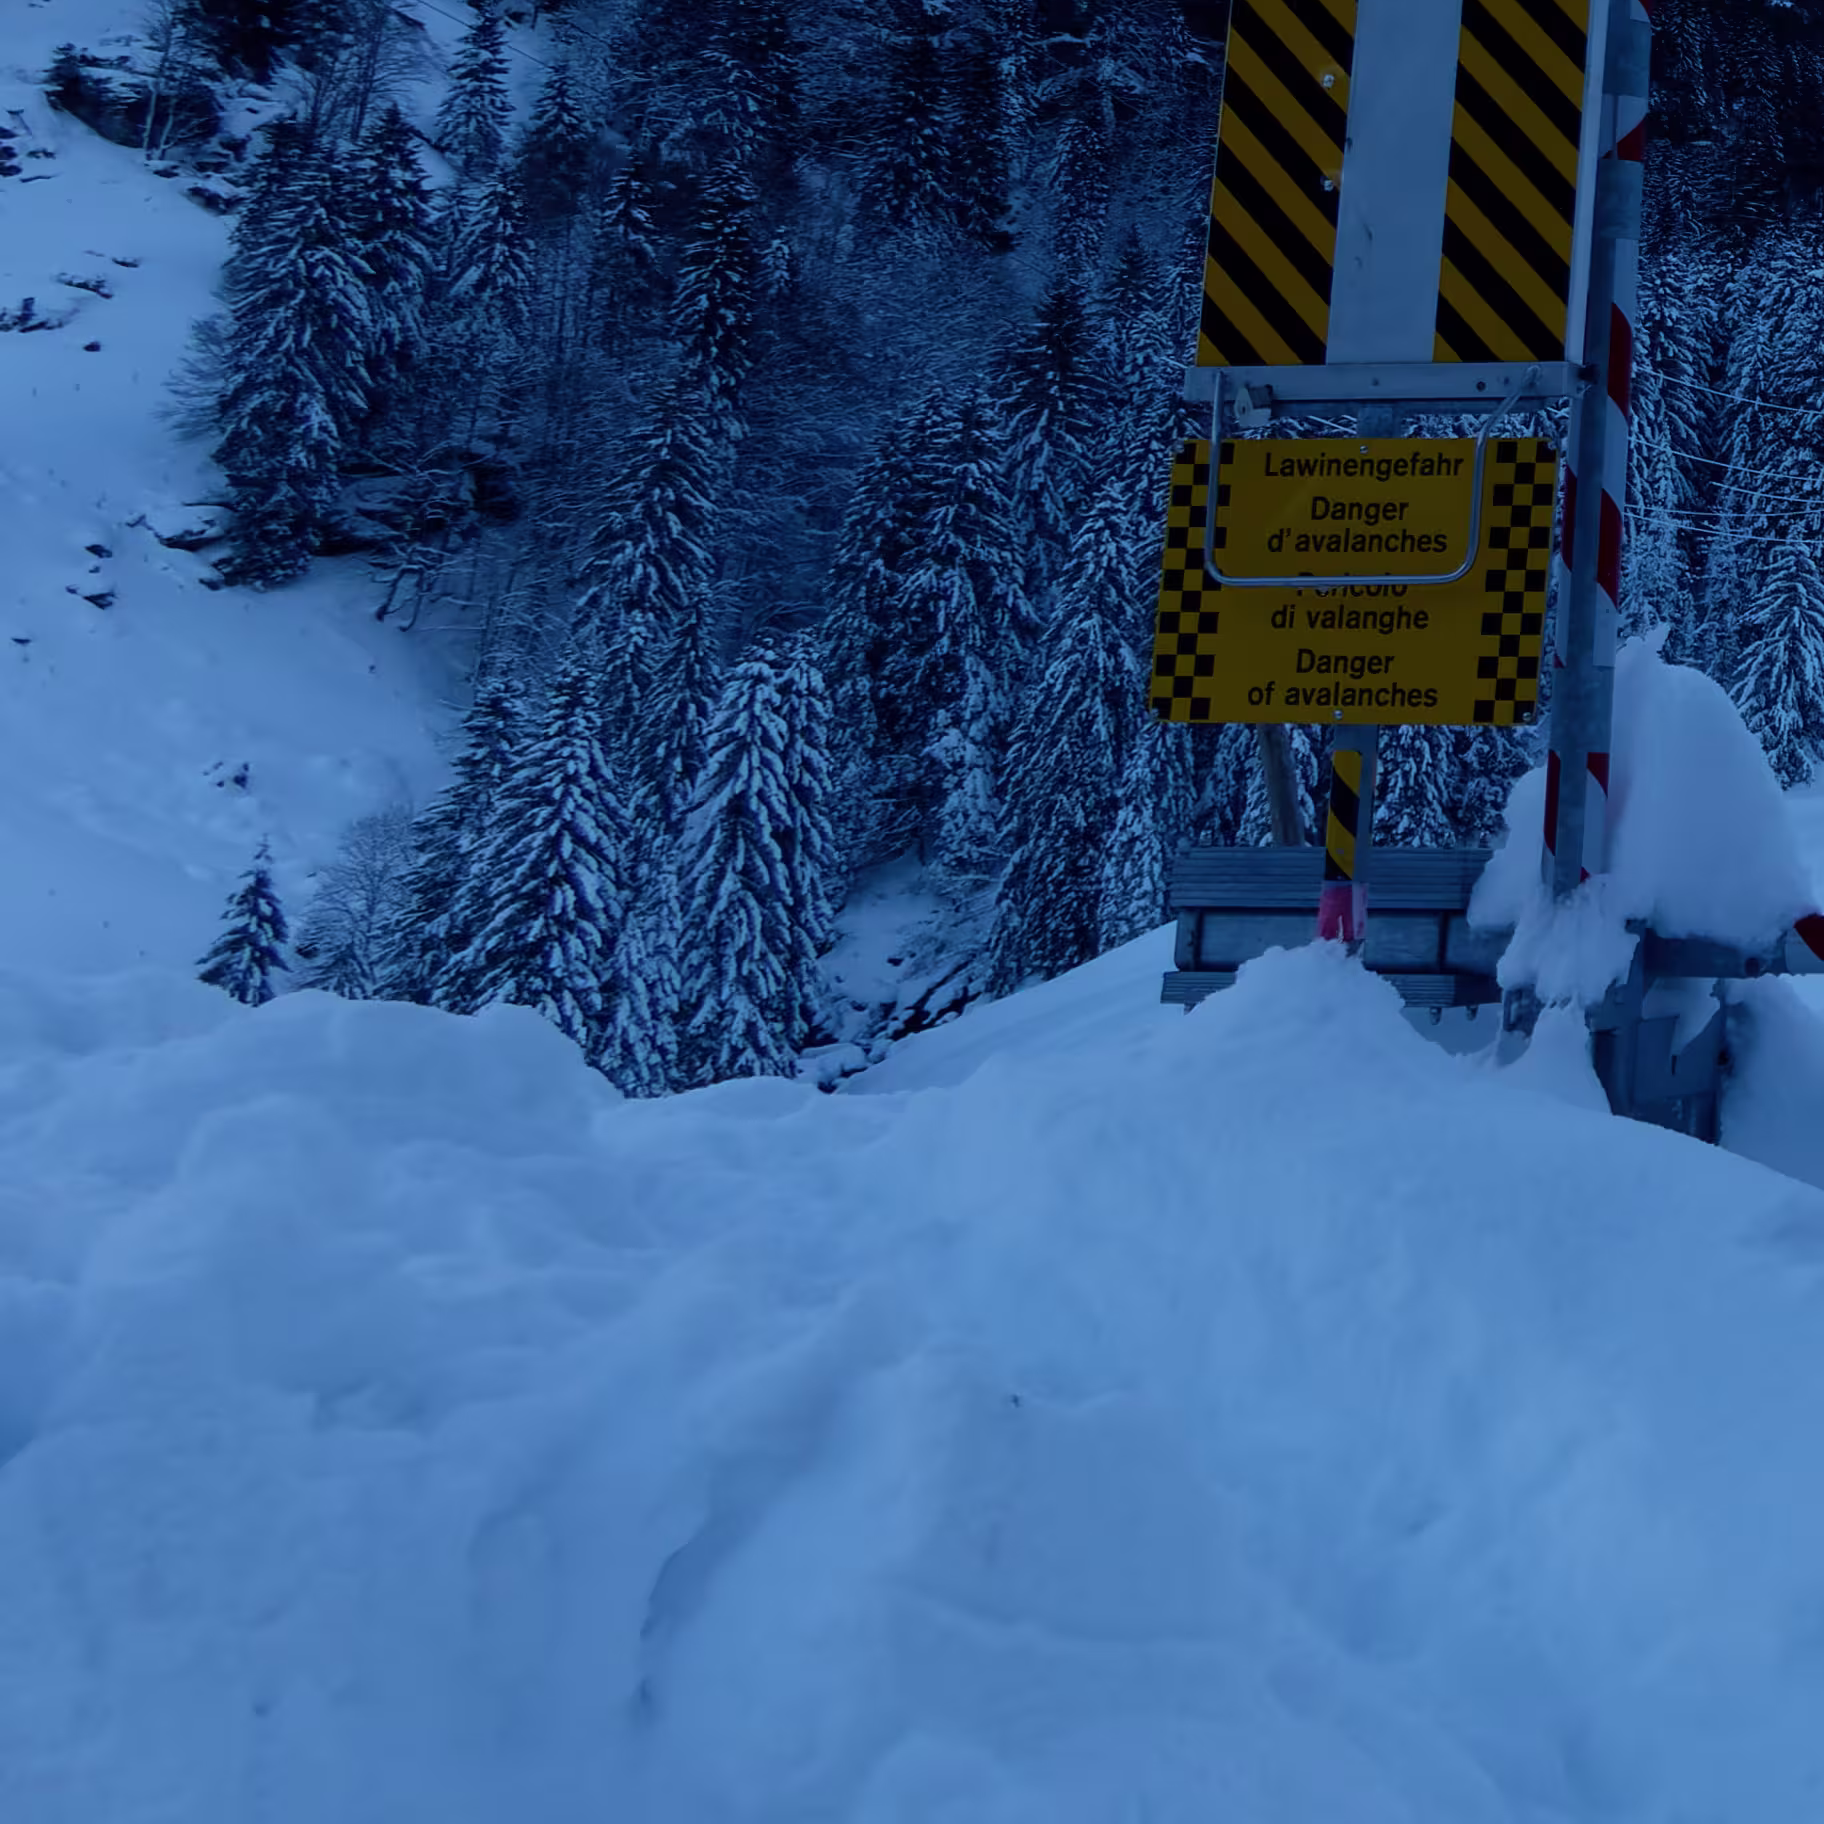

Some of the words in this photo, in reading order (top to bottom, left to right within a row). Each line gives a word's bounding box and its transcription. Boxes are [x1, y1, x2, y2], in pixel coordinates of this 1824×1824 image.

[1264, 452, 1465, 481] Lawinengefahr
[1310, 496, 1409, 525] Danger
[1270, 605, 1295, 629] di
[1306, 605, 1429, 634] valanghe
[1295, 648, 1394, 677] Danger
[1248, 681, 1276, 706] of
[1284, 681, 1438, 707] avalanches
